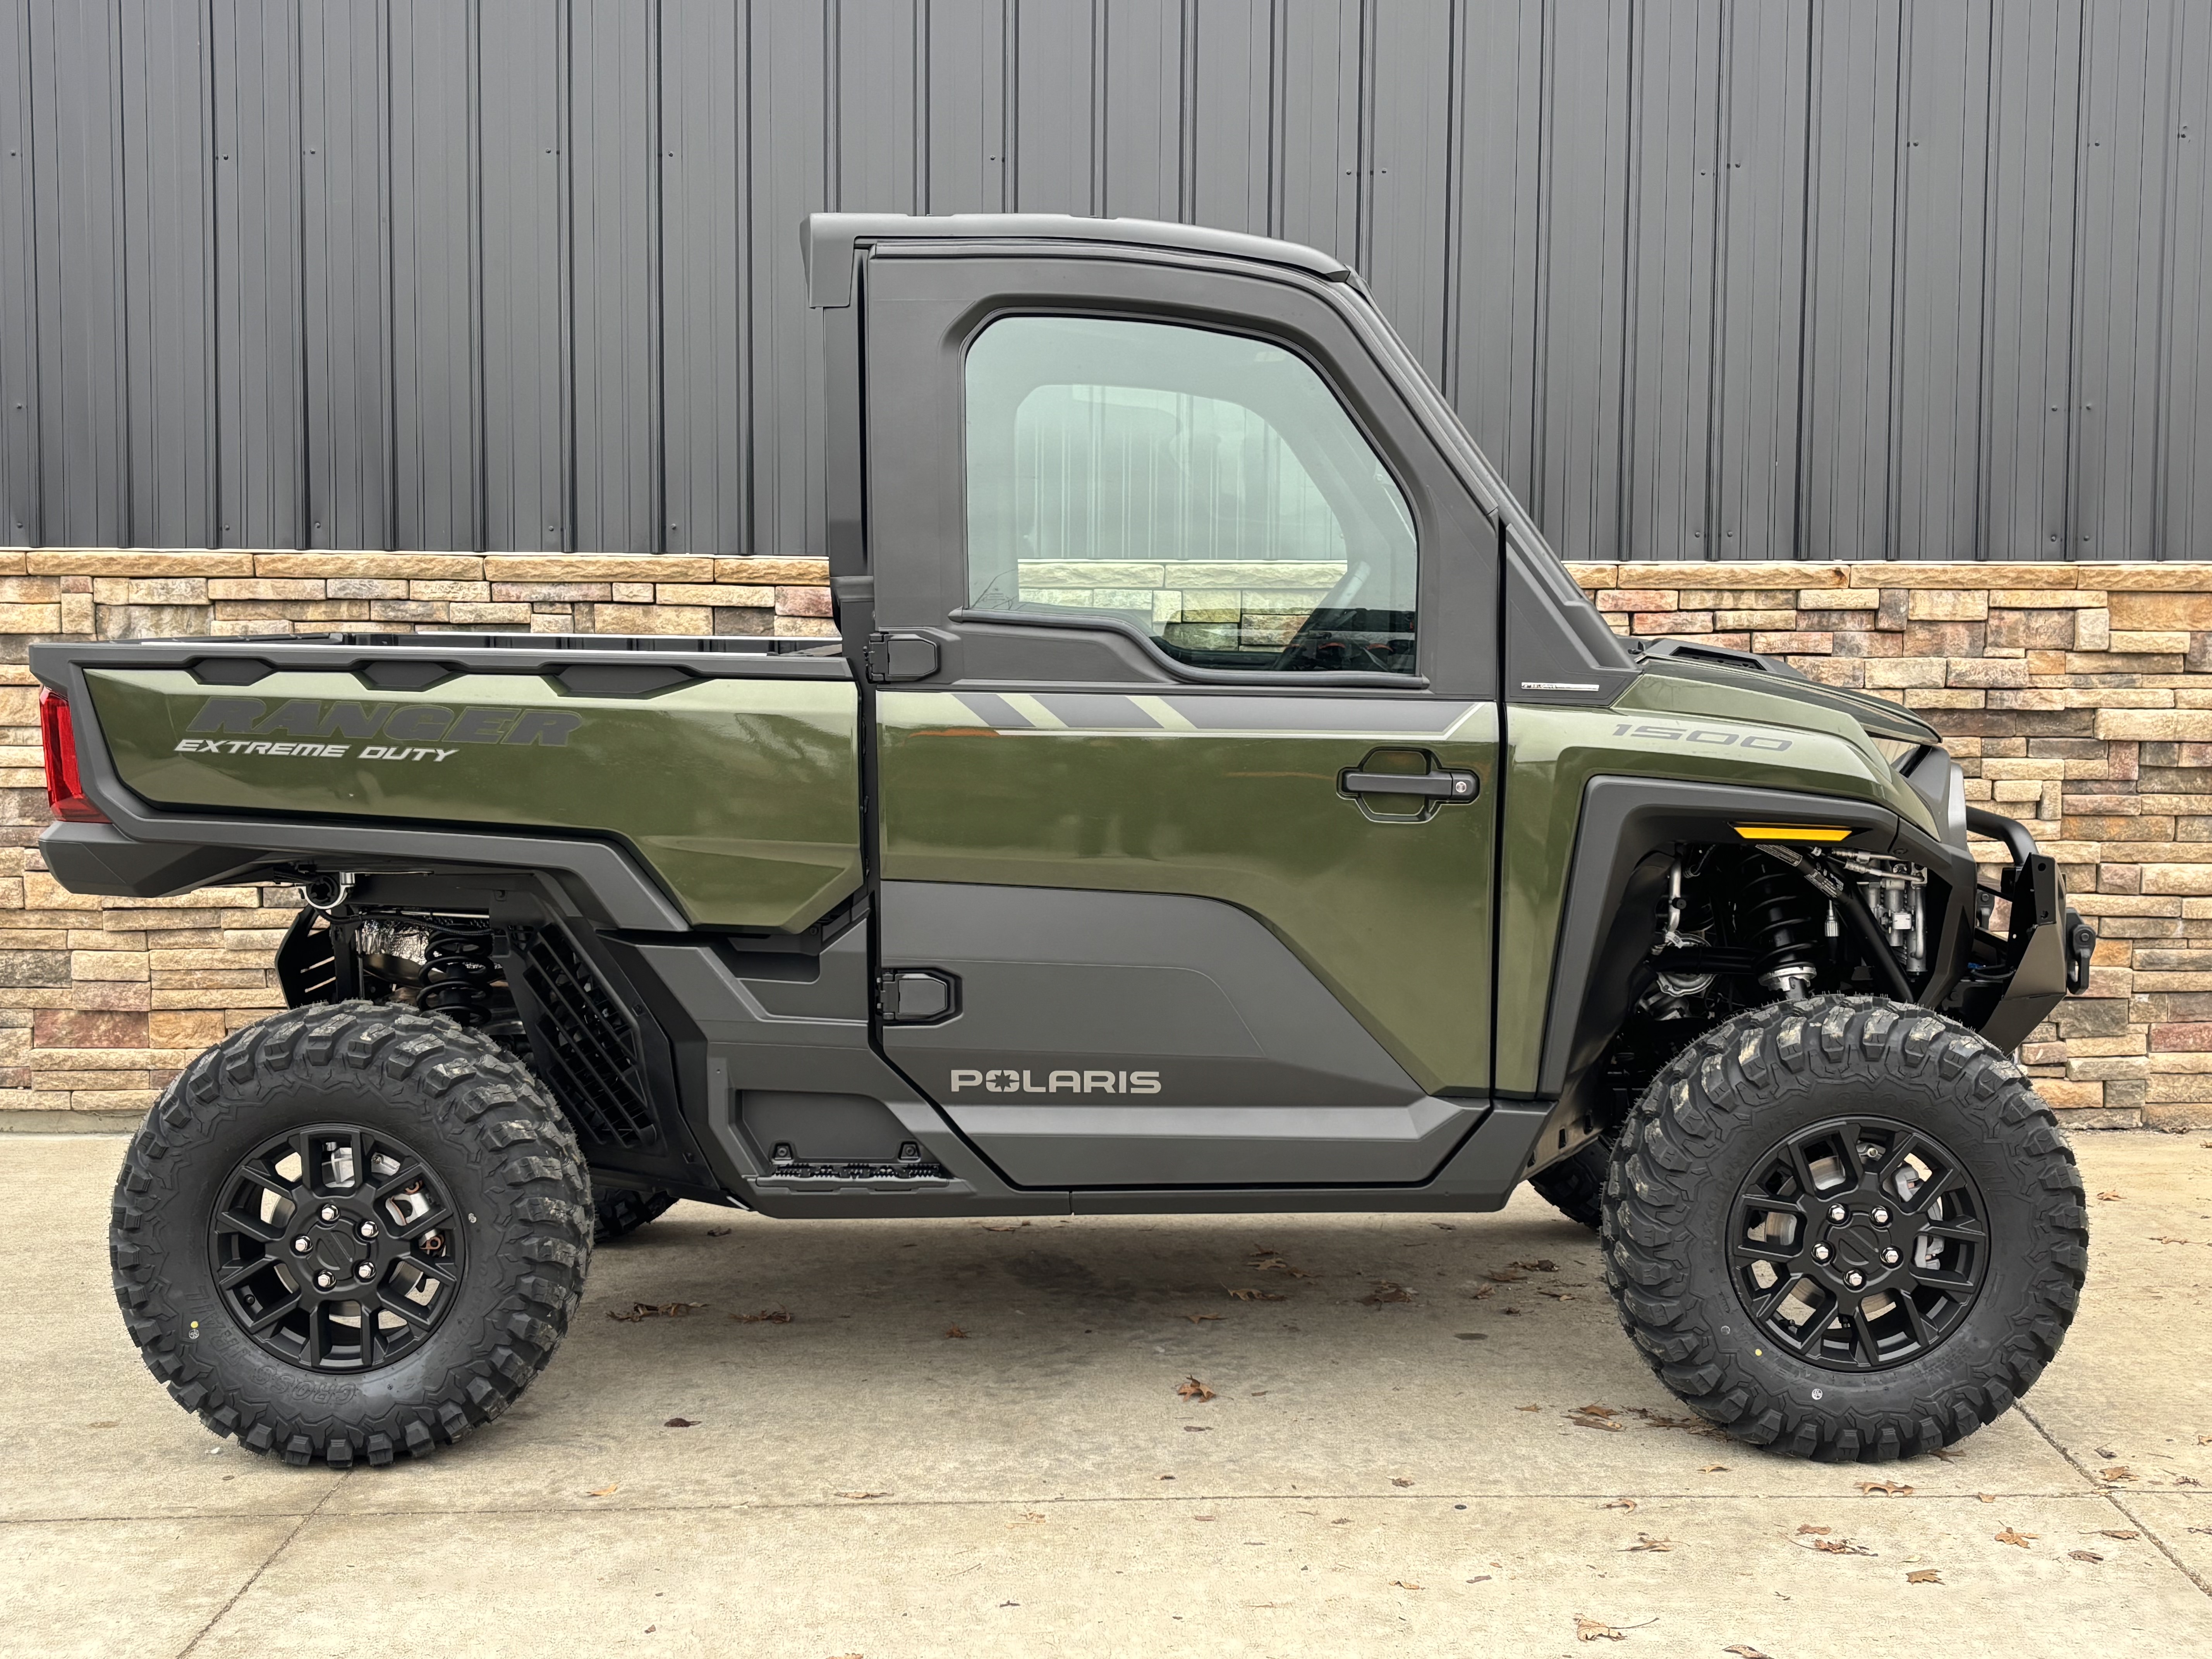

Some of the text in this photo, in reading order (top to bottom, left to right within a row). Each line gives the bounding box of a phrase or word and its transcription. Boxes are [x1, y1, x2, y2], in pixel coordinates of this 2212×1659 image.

[186, 696, 582, 747] RANGER
[1612, 724, 1793, 752] 1500
[175, 739, 458, 762] EXTREME DUTY
[951, 1070, 1162, 1094] POLARIS
[1832, 1090, 2012, 1202] CROSS TRAIL
[184, 1283, 357, 1406] CROSS TRAIL
